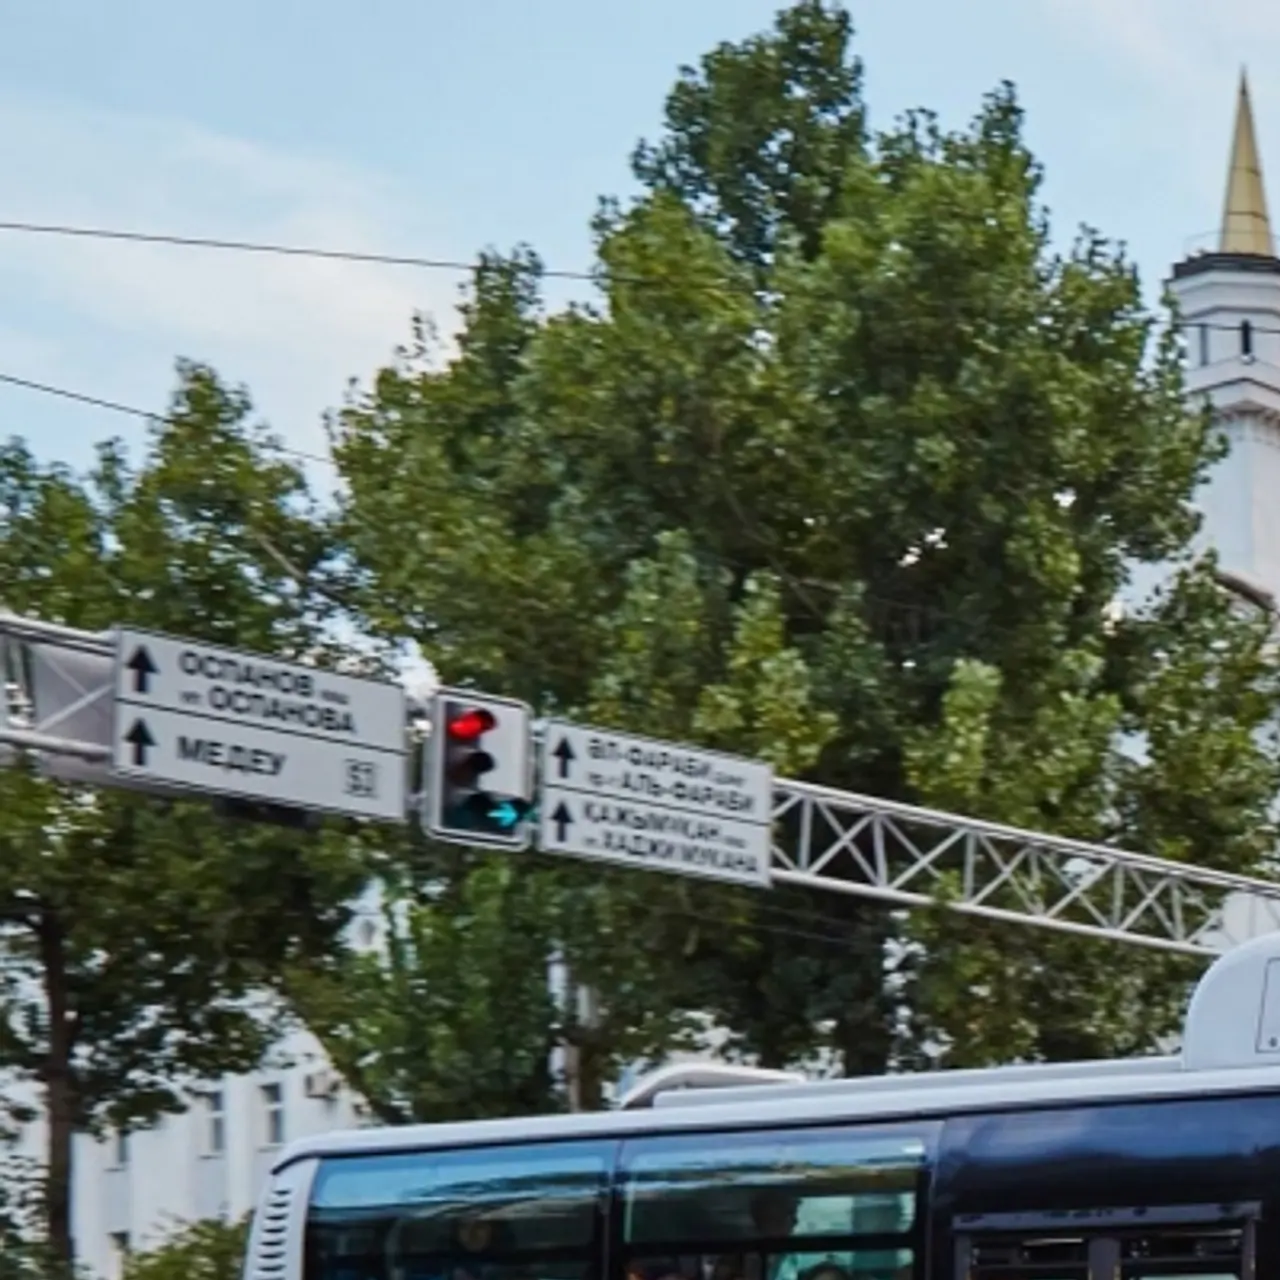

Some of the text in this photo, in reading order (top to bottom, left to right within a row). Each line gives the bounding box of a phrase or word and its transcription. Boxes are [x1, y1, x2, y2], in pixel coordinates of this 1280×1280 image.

[179, 651, 314, 697] ОСПАНОВ
[208, 685, 356, 733] ОСПАНОВА
[177, 735, 287, 776] МЕДЕУ
